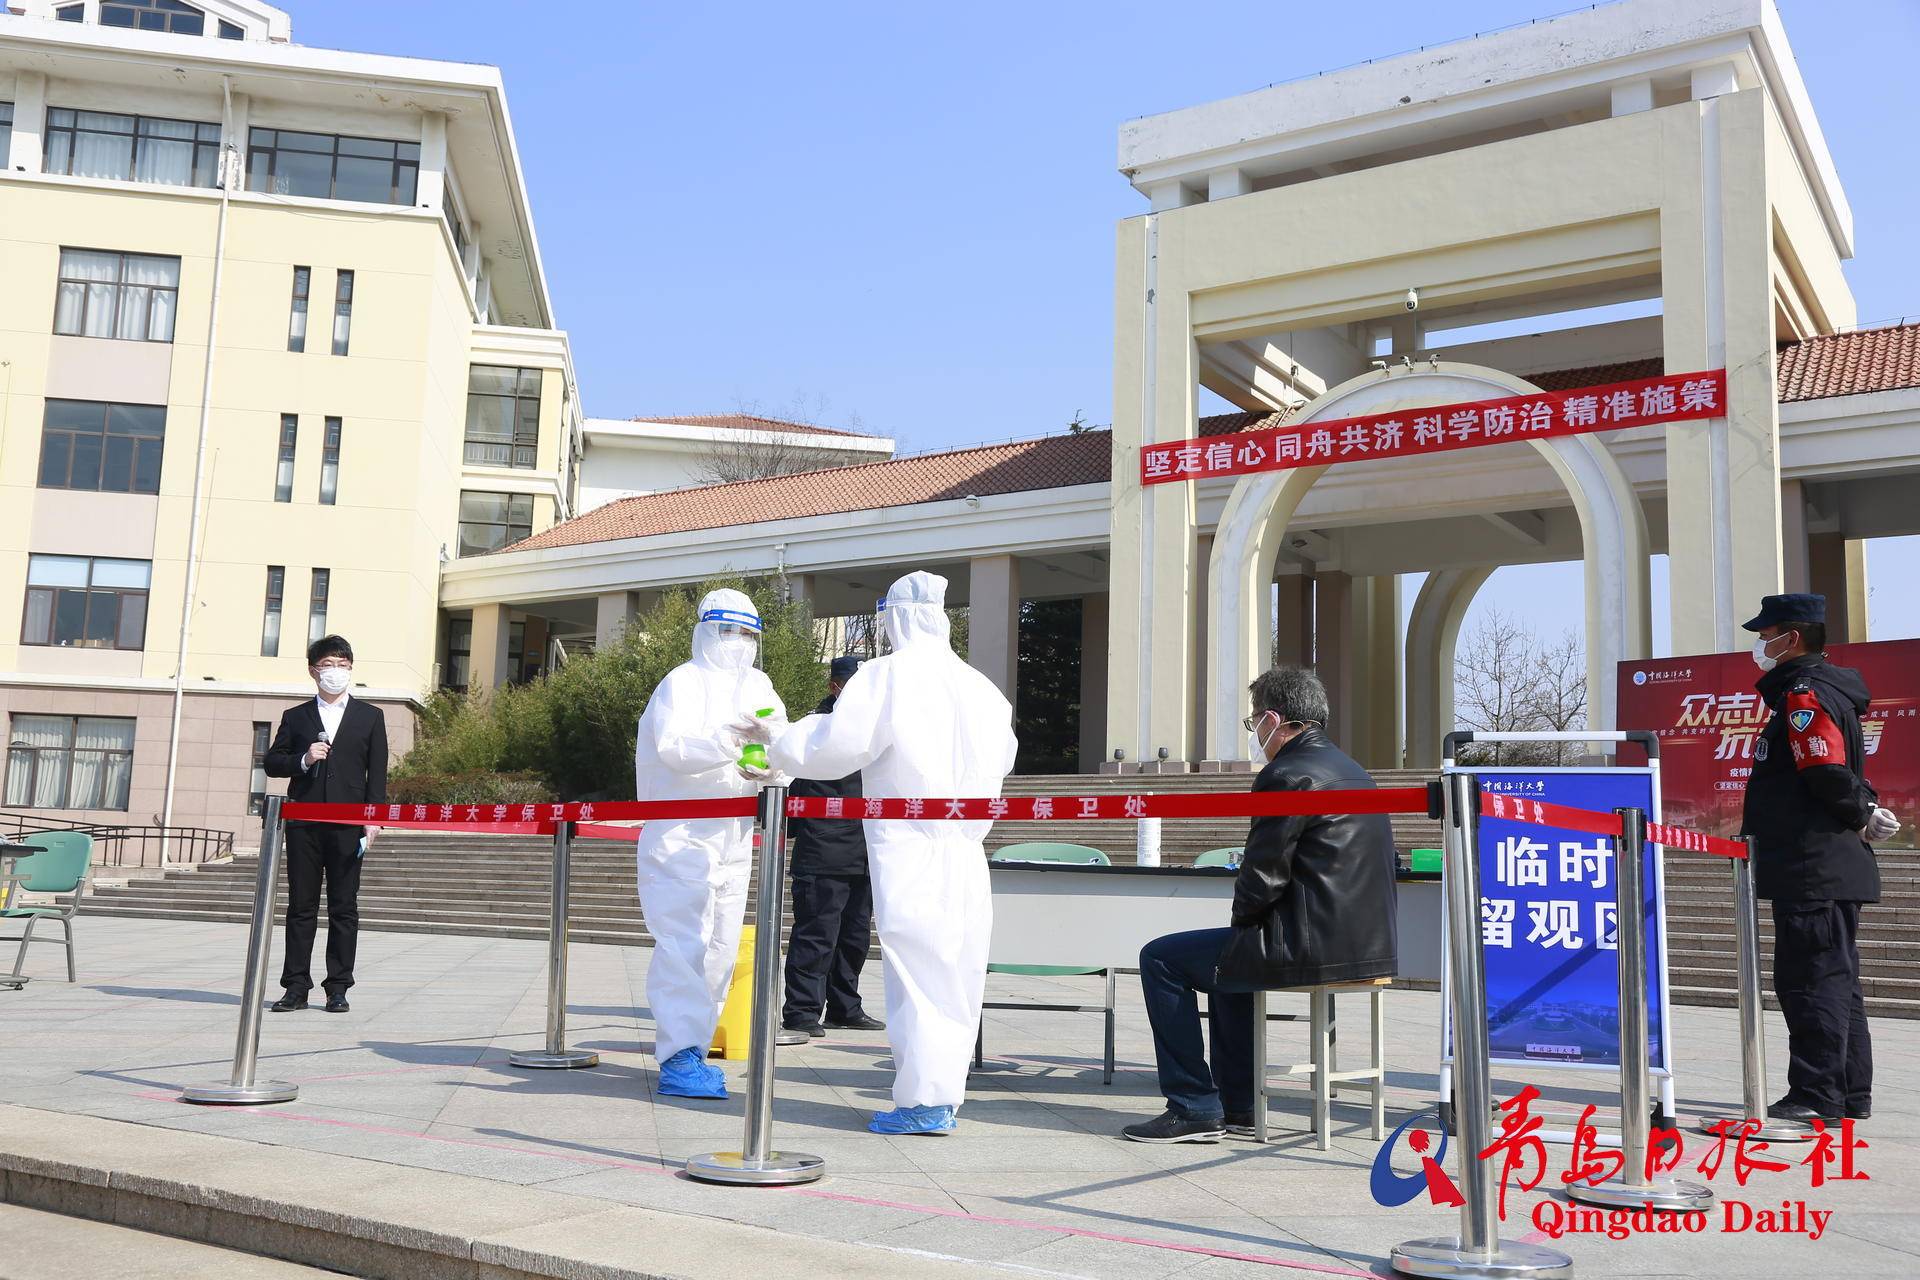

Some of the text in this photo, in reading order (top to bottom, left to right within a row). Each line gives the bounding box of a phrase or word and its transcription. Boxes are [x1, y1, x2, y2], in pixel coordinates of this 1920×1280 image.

[1144, 378, 1719, 478] 坚定信心 同舟共济 科学防治 精准施策
[1860, 710, 1889, 719] 成城
[363, 803, 596, 823] 中国海洋大学保卫处
[787, 796, 1148, 819] 中国海洋大学保卫处
[1493, 795, 1545, 824] 保卫处
[1496, 836, 1614, 889] 临时
[1481, 897, 1618, 950] 留观区
